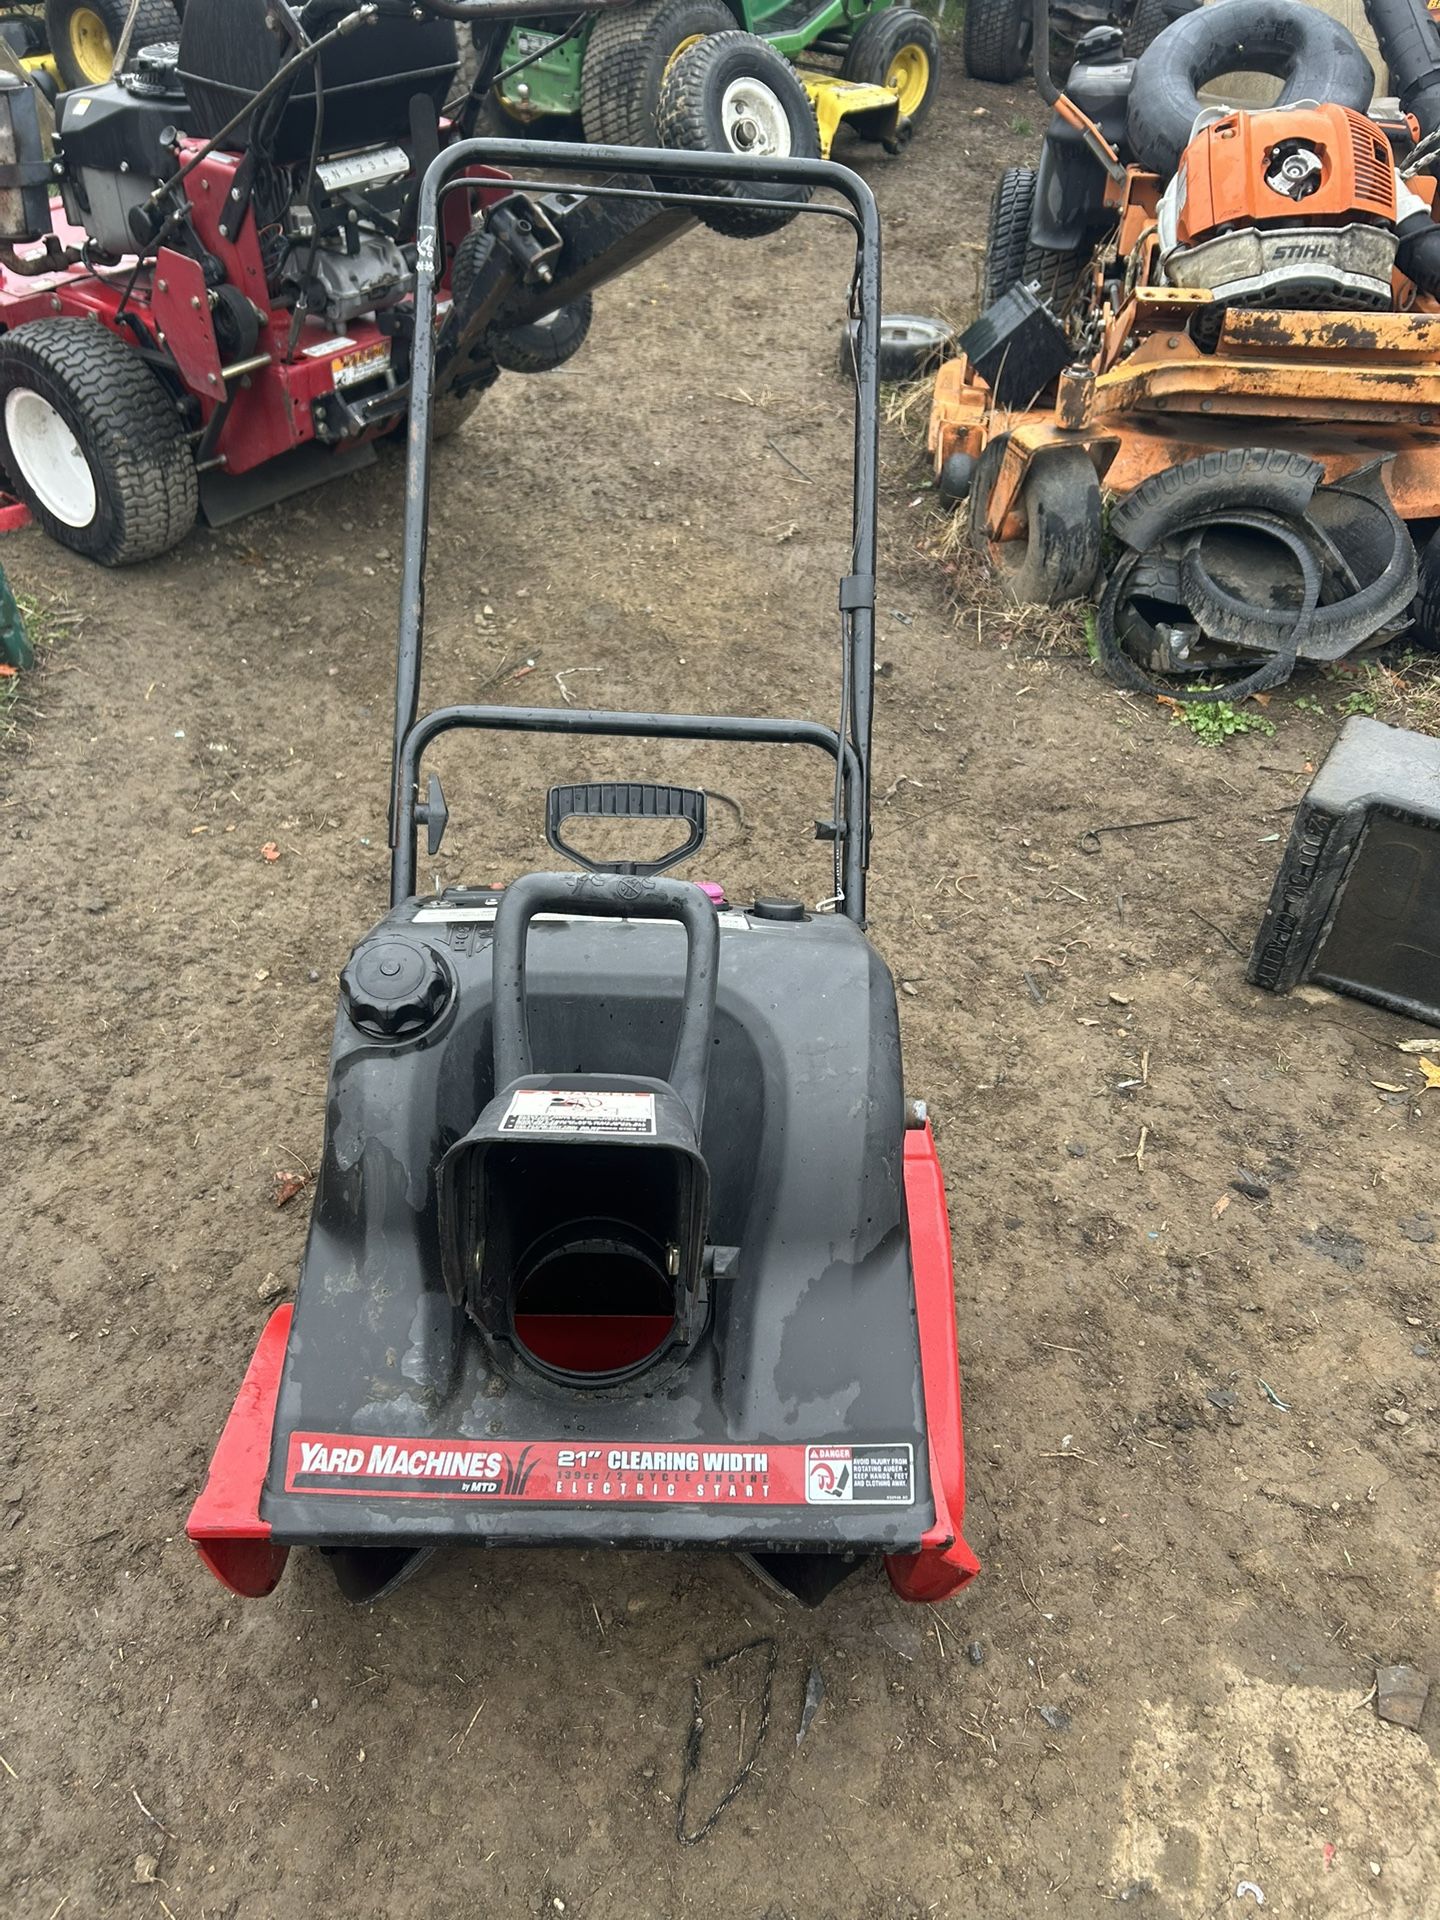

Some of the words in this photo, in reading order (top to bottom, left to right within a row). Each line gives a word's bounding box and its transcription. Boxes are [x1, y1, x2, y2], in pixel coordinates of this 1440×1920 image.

[323, 175, 331, 187] R
[331, 169, 340, 179] N
[368, 161, 376, 170] 3
[1272, 245, 1330, 260] STIHL
[1259, 911, 1298, 984] CAPACITY
[300, 1442, 365, 1475] YARD
[366, 1445, 503, 1478] MACHINES
[607, 1450, 699, 1471] CLEARING
[702, 1452, 768, 1473] WIDTH
[820, 1449, 851, 1458] DANGER
[637, 1471, 691, 1482] CYCLE
[704, 1474, 769, 1483] ENGINE
[471, 1482, 497, 1493] MTD
[556, 1481, 676, 1496] ELECTRIC
[696, 1484, 770, 1498] START
